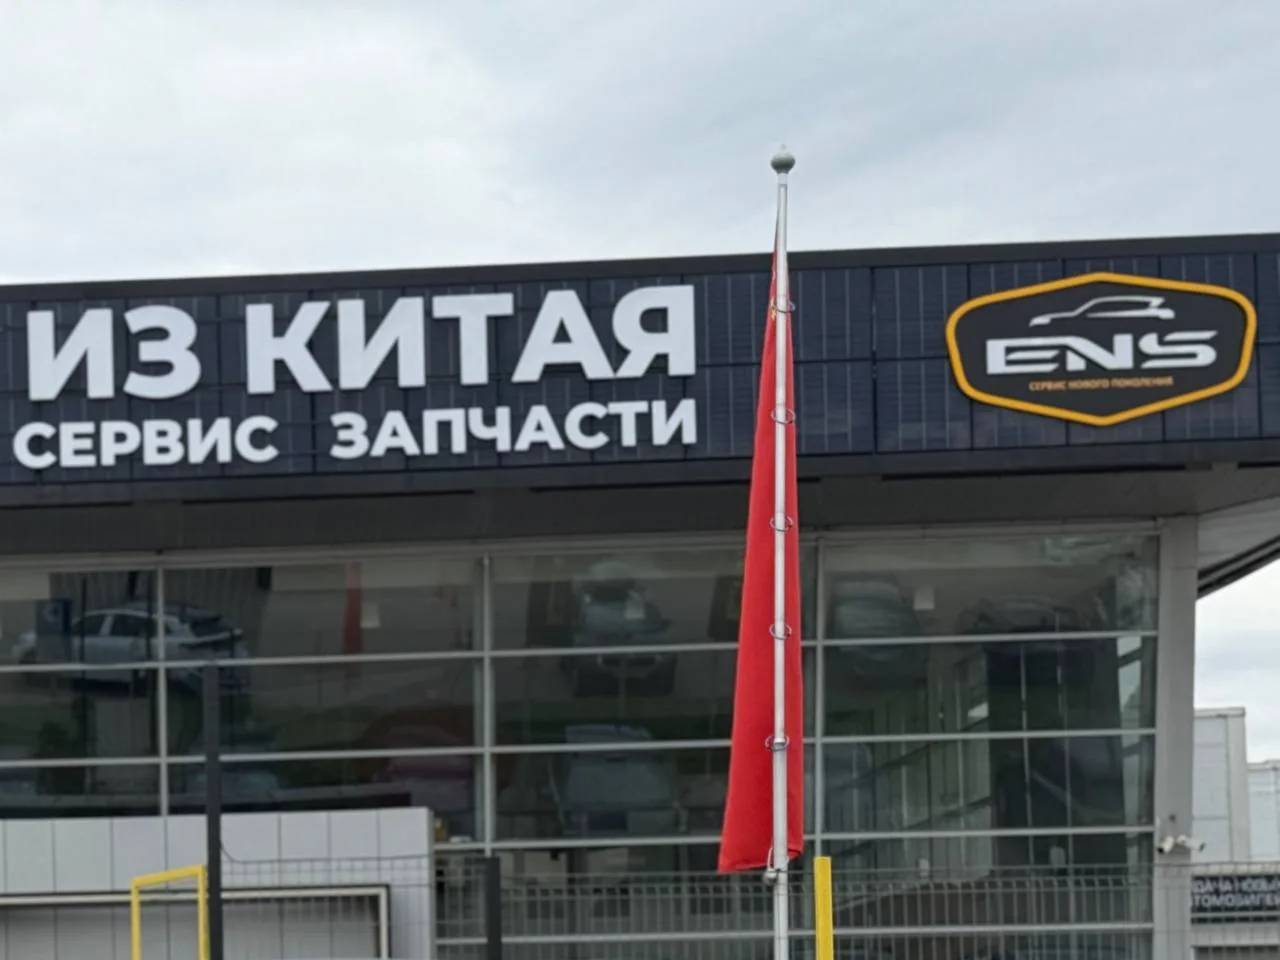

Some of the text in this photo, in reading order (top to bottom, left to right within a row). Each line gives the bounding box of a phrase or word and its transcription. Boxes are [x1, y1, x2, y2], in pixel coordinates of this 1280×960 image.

[28, 306, 200, 400] ИЗ
[246, 285, 695, 394] КИТАЯ
[986, 330, 1218, 374] ENS
[13, 416, 278, 467] СЕРВИС
[330, 399, 697, 458] ЗАПЧАСТИ
